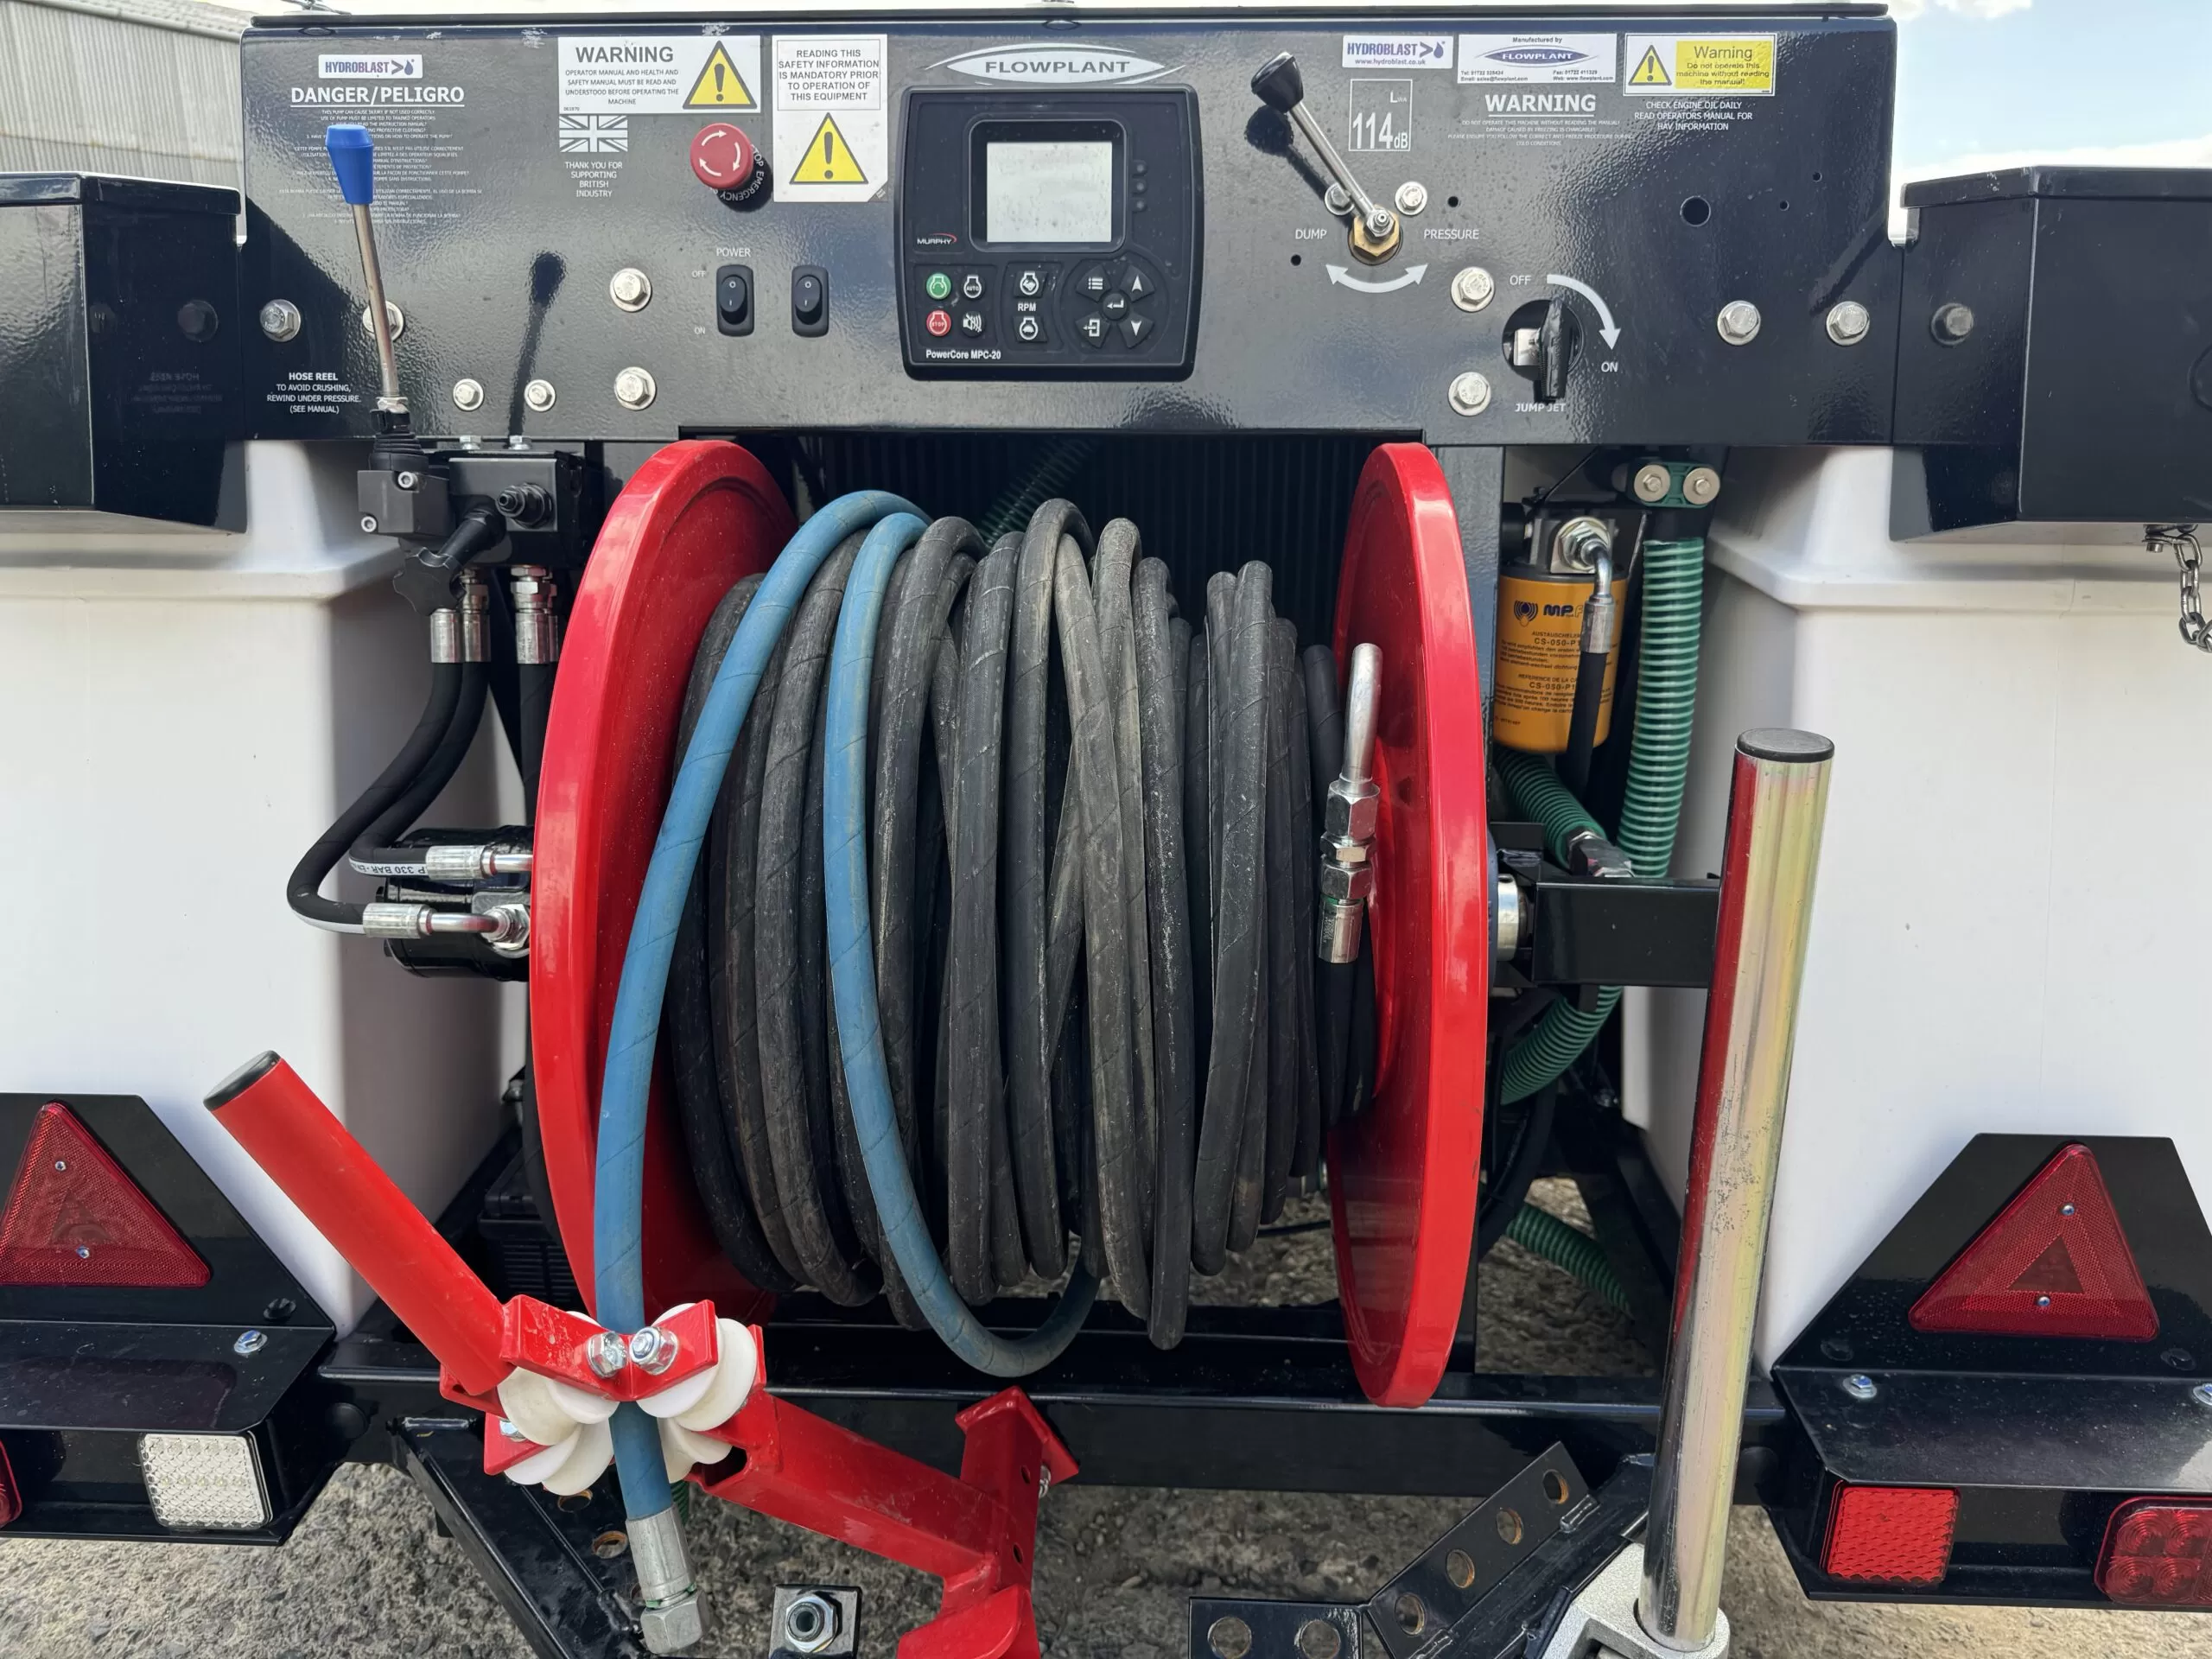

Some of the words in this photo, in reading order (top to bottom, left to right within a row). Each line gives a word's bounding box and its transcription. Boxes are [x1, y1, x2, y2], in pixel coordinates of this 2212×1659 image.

[1347, 42, 1417, 56] HYDROBLAST
[1694, 46, 1752, 61] Warning
[575, 46, 674, 63] WARNING
[325, 61, 390, 73] HYDROBLAST
[779, 60, 814, 69] SAFETY
[985, 60, 1130, 73] FLOWPLANT
[802, 81, 855, 90] OPERATION
[290, 86, 465, 105] DANGER/PELIGRO
[1484, 94, 1597, 112] WARNING
[720, 171, 764, 200] EMERGENCY
[1295, 229, 1326, 239] DUMP
[1424, 229, 1479, 239] PRESSURE
[716, 247, 751, 257] POWER
[1510, 276, 1531, 285] OFF
[1018, 302, 1037, 312] RPM
[926, 349, 968, 359] PowerCore
[970, 349, 1001, 359] MPC-20
[1601, 362, 1618, 372] ON
[289, 405, 306, 414] (SEE
[308, 405, 340, 414] MANUAL)
[1515, 404, 1545, 413] JUMP
[1547, 404, 1566, 413] JET
